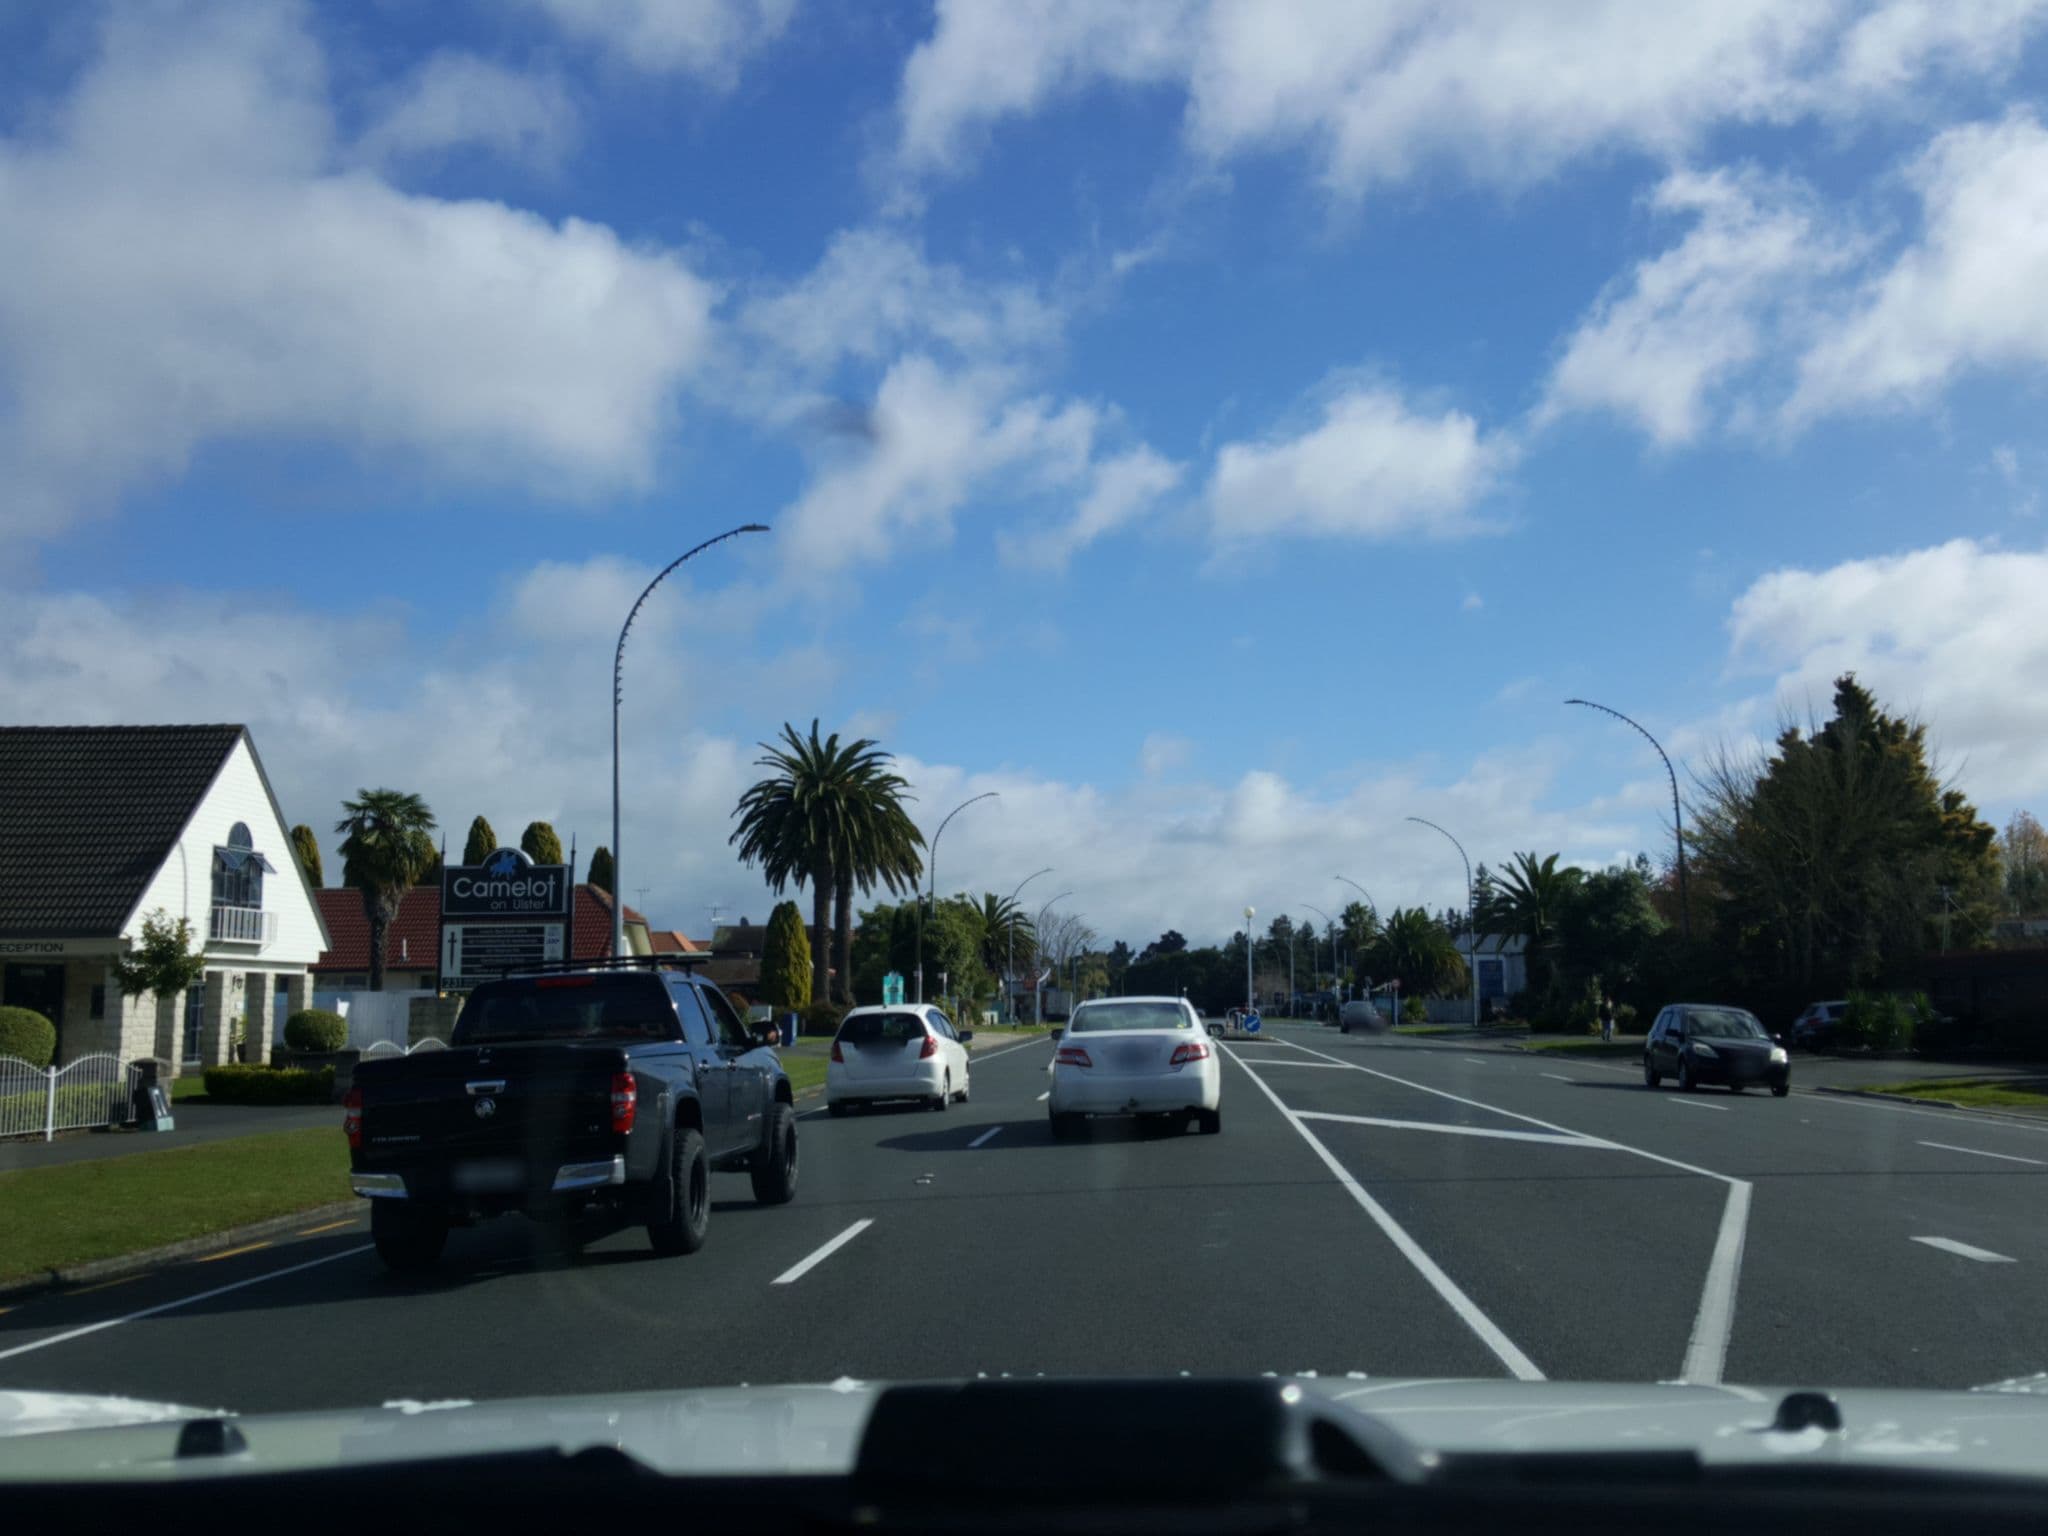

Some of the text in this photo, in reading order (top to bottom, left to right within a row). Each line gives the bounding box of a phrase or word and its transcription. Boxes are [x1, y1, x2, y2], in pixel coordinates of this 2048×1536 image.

[453, 874, 556, 908] Camelot
[490, 899, 545, 910] on Ulster
